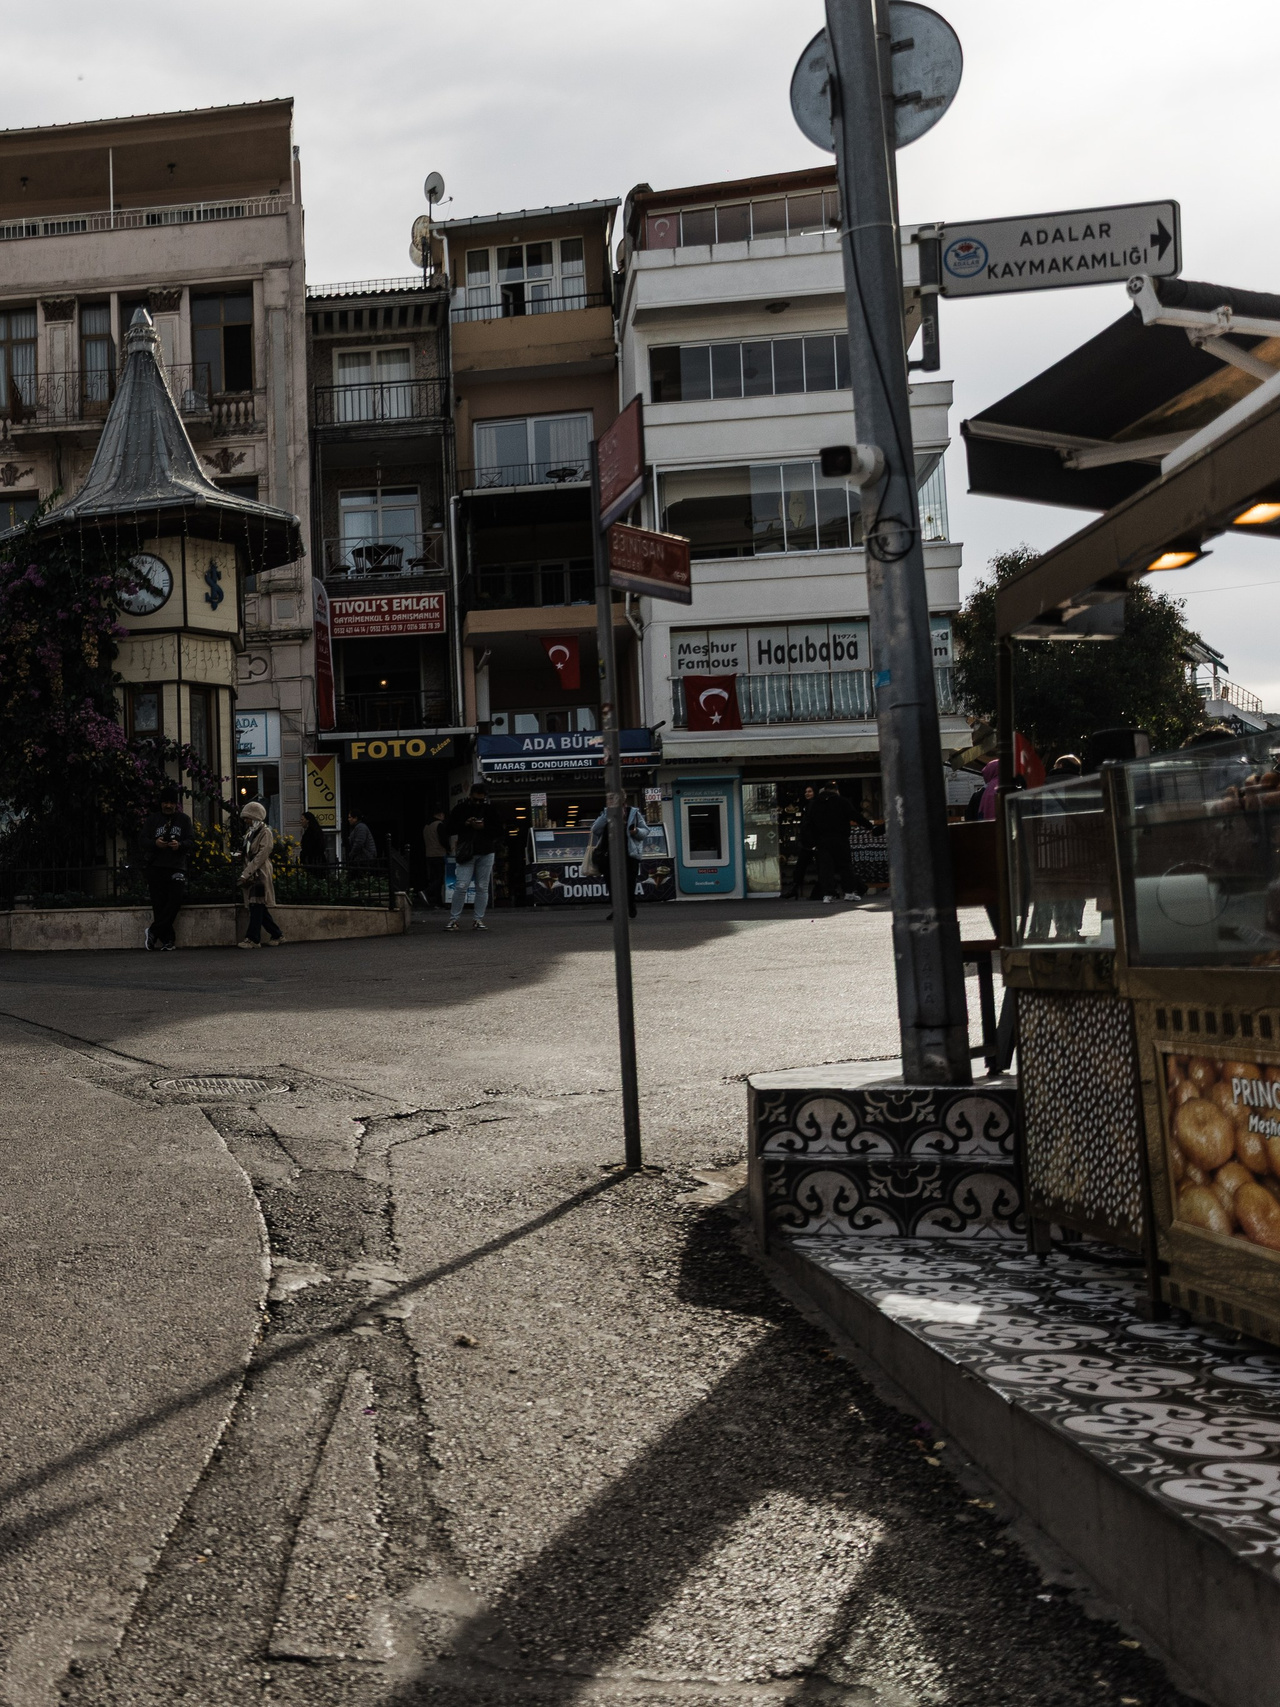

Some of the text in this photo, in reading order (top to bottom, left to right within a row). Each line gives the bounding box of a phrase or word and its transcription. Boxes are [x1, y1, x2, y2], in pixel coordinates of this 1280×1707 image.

[1020, 223, 1111, 247] ADALAR
[987, 247, 1147, 280] KAYMAKAMLIĞI
[333, 599, 388, 614] TIVOLI'S
[392, 597, 439, 611] EMLAK
[334, 615, 383, 624] GAYRİMENKUL
[678, 642, 737, 656] Meşhur
[758, 635, 858, 665] Hacıbaba
[678, 657, 738, 670] Famous
[351, 738, 426, 760] FOTO
[522, 738, 556, 751] ADA
[494, 762, 526, 770] MARAŞ
[531, 759, 592, 769] DONDURMASI
[307, 769, 335, 802] FOTO
